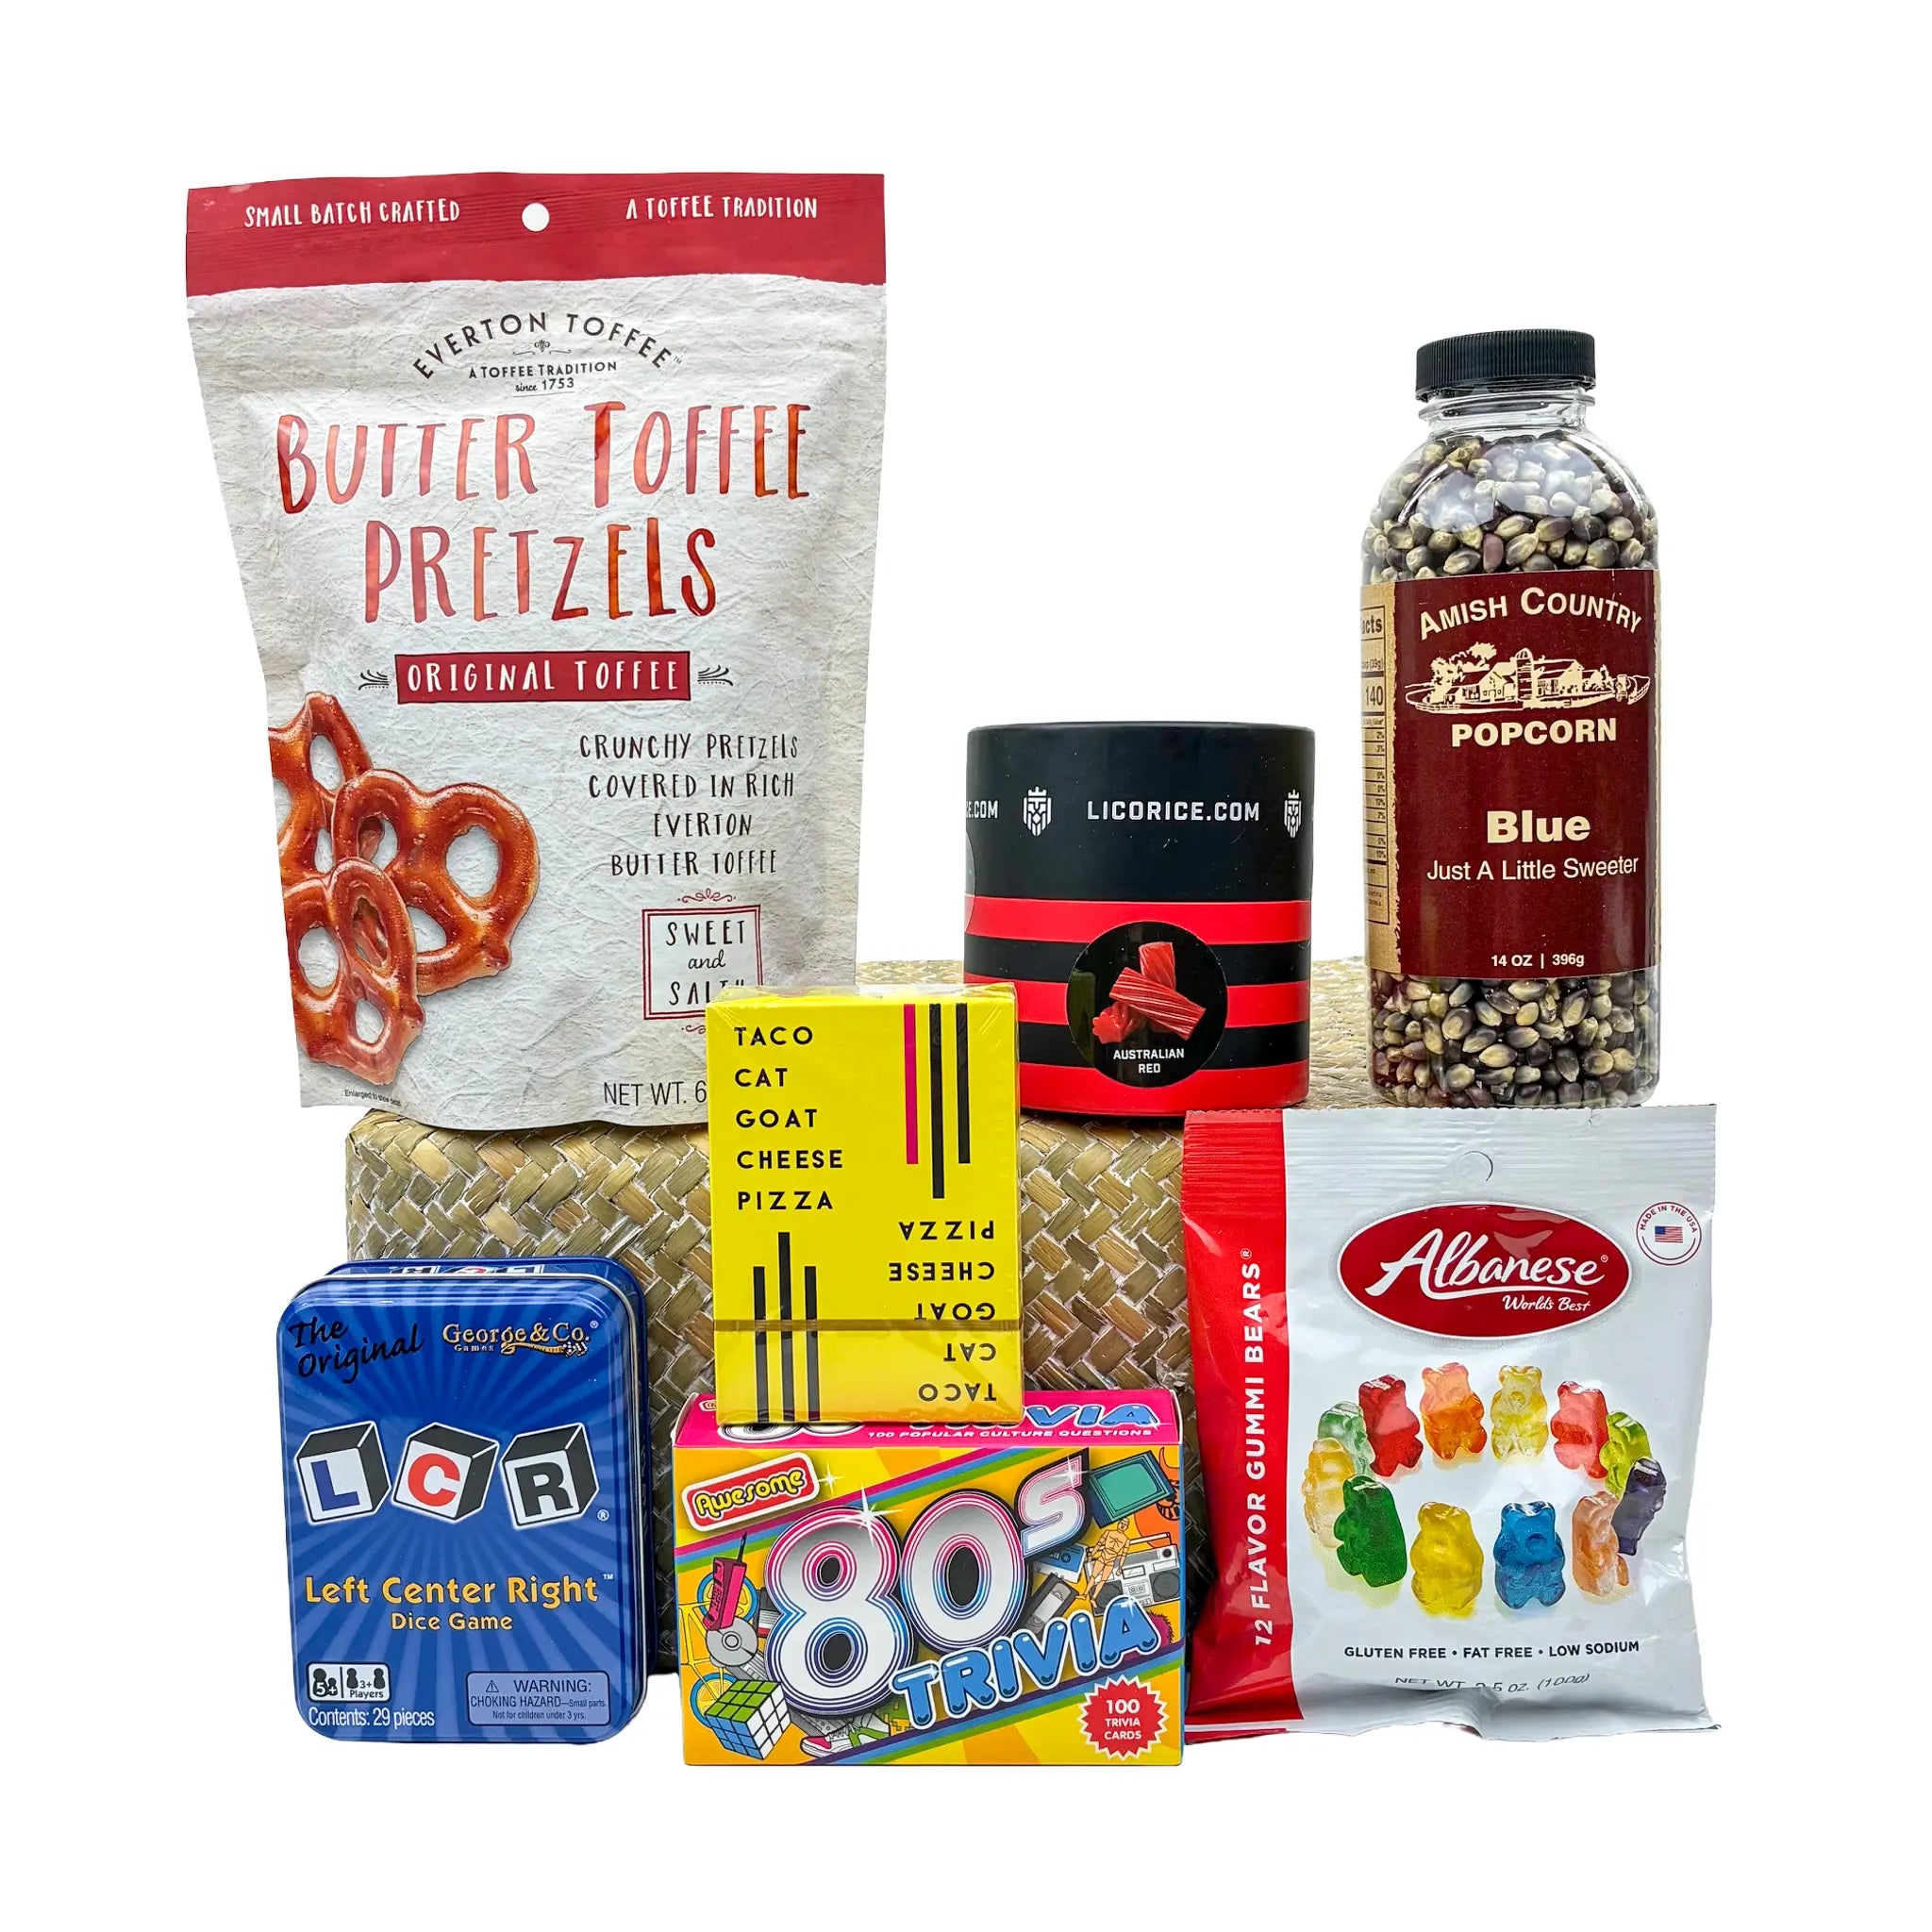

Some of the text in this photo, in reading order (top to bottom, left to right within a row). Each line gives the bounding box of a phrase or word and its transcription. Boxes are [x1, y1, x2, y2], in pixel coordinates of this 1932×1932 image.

[244, 199, 460, 228] SMALL BATCH CRAFTED
[625, 196, 818, 219] A TOFFEE TRADITION
[412, 311, 546, 379] EVERTON
[469, 361, 617, 378] A TOFFEE TRADITION
[515, 377, 575, 391] since 1753
[276, 401, 810, 514] BUTTER TOFFEE
[364, 516, 716, 624] PRETZELS
[1419, 586, 1642, 641] AMISH COUNTRY
[408, 659, 678, 692] ORIGINAL TOFFEE
[1366, 686, 1384, 707] 140
[1451, 718, 1617, 747] POPCORN
[580, 733, 799, 758] CRUNCHY PRETZELS
[589, 773, 794, 799] COVERED IN RICH
[1088, 800, 1259, 822] LICORICE.COM
[655, 812, 752, 837] EVERTON
[1487, 810, 1590, 844] Blue
[611, 850, 777, 876] BUTTER TOFFEE
[1427, 857, 1639, 881] Just A Little Sweeter
[666, 920, 744, 946] SWEET
[688, 949, 725, 969] and
[1491, 954, 1585, 968] 14 OZ 396g
[734, 1025, 813, 1046] TACO
[1113, 1048, 1185, 1060] AUSTRALIAN
[735, 1067, 788, 1088] CAT
[1139, 1063, 1160, 1074] RED
[604, 1082, 643, 1107] NET
[651, 1082, 686, 1106] WT.
[736, 1108, 818, 1129] GOAT
[737, 1149, 842, 1170] CHEESE
[737, 1191, 833, 1210] PIZZA
[898, 1220, 995, 1240] PIZZA
[1640, 1209, 1657, 1230] MADE
[1670, 1206, 1687, 1216] THE
[1686, 1216, 1697, 1233] USA
[889, 1261, 995, 1282] CHEESE
[914, 1302, 995, 1322] GOAT
[1502, 1294, 1591, 1311] World's Best
[288, 1317, 348, 1349] The
[298, 1324, 424, 1384] Original
[454, 1344, 494, 1353] Games
[943, 1343, 996, 1362] CAT
[918, 1382, 997, 1402] TACO
[1245, 1376, 1266, 1479] GUMMI
[696, 1469, 806, 1518] Awesome
[1247, 1492, 1271, 1609] FLAVOR
[307, 1575, 370, 1604] Left
[382, 1577, 495, 1604] Center
[391, 1613, 513, 1631] Dice Game
[1255, 1621, 1273, 1645] 12
[1344, 1641, 1639, 1658] GLUTEN FREE FAT FREE LOW SODIUM
[891, 1598, 1161, 1729] TRIVIA
[316, 1682, 337, 1695] 5+
[514, 1680, 591, 1692] WARNING:
[1538, 1674, 1590, 1690] (100g)
[349, 1690, 383, 1699] Players
[471, 1696, 516, 1707] CHOKING
[589, 1699, 607, 1708] parts.
[492, 1710, 505, 1719] Not
[507, 1710, 516, 1719] for
[518, 1710, 544, 1720] children
[546, 1710, 565, 1720] under
[567, 1710, 572, 1719] 3
[1107, 1699, 1140, 1714] 100
[308, 1707, 435, 1729] Contents: 29 pieces
[1106, 1718, 1141, 1726] TRIVIA
[1104, 1731, 1141, 1740] CARDS
